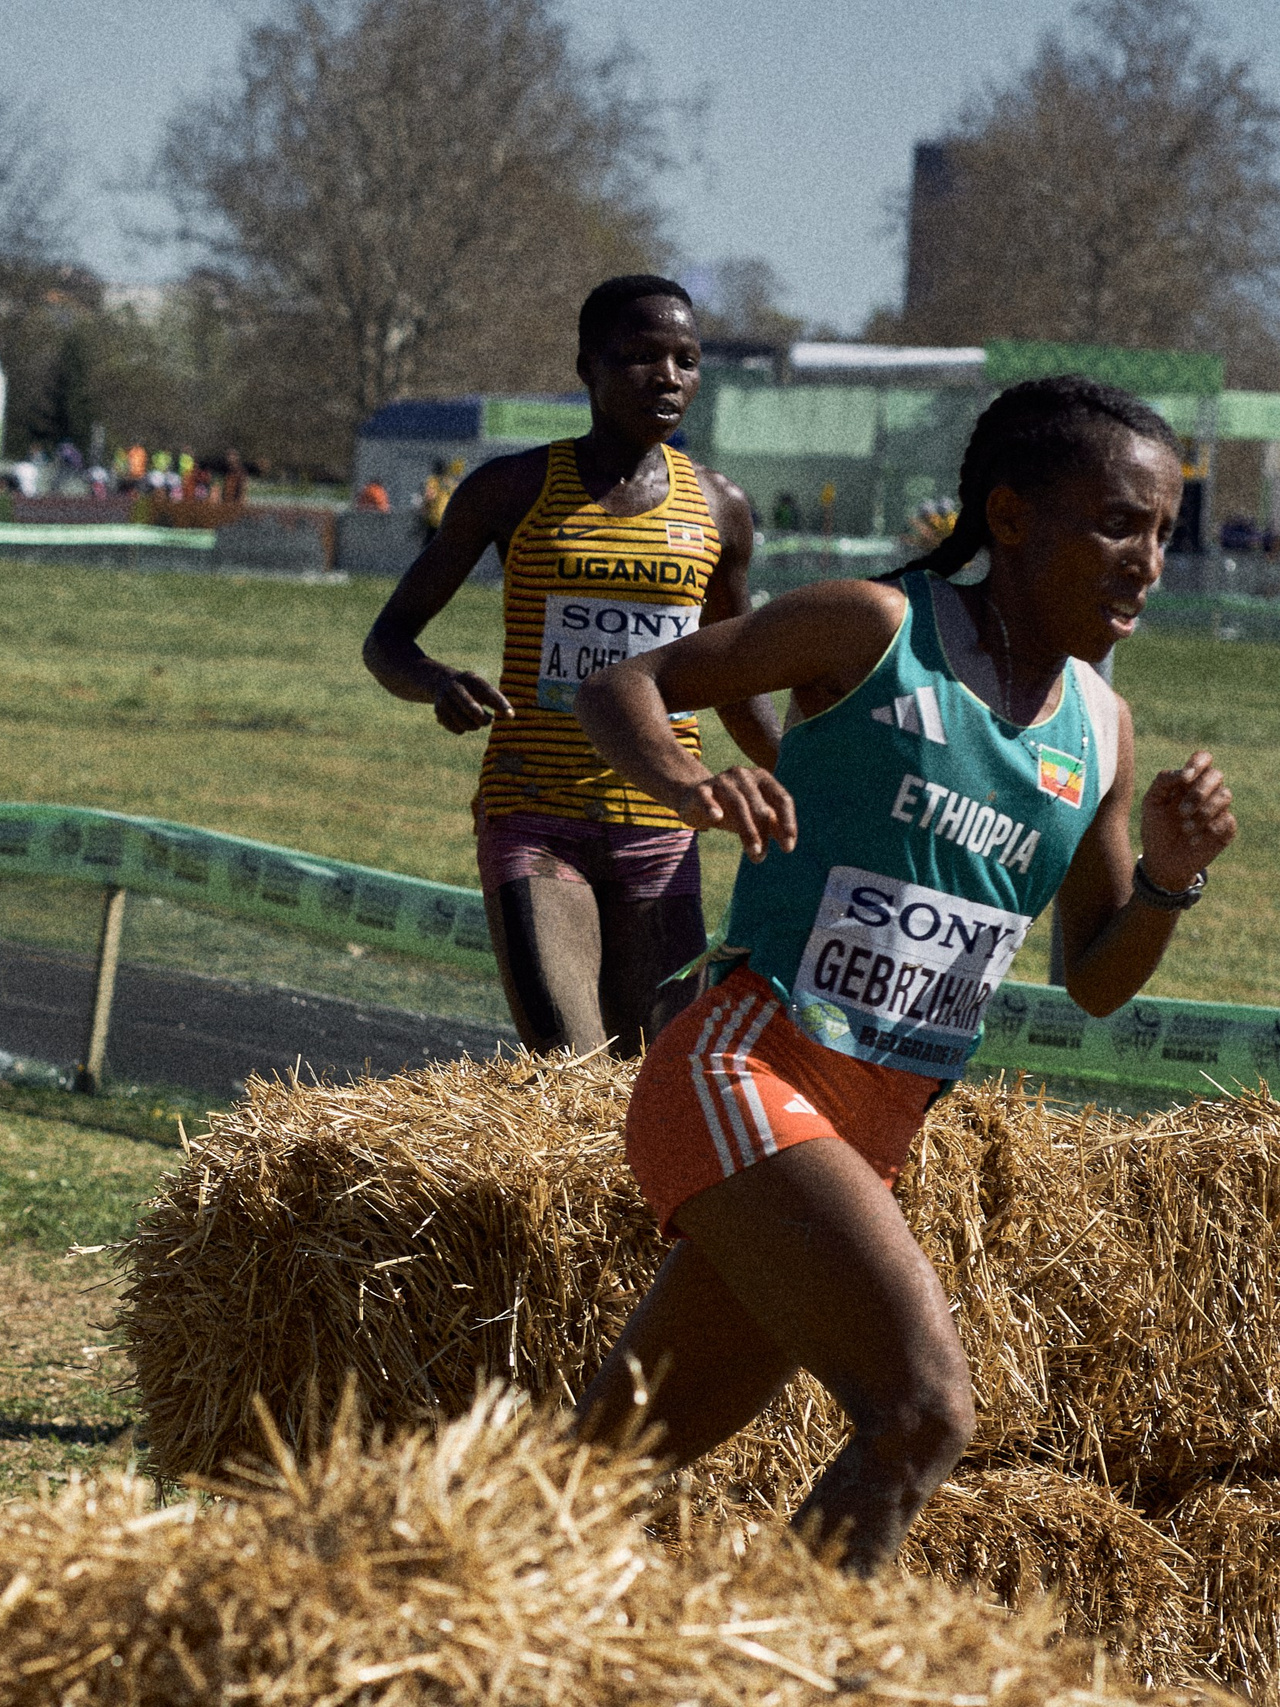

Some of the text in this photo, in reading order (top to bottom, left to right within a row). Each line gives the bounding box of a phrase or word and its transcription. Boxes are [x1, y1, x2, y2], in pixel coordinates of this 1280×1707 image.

[557, 557, 697, 588] UGANDA
[562, 604, 691, 637] SONY
[547, 642, 567, 678] A.
[891, 773, 1041, 874] ETHIOPIA
[847, 886, 1014, 959] SONY
